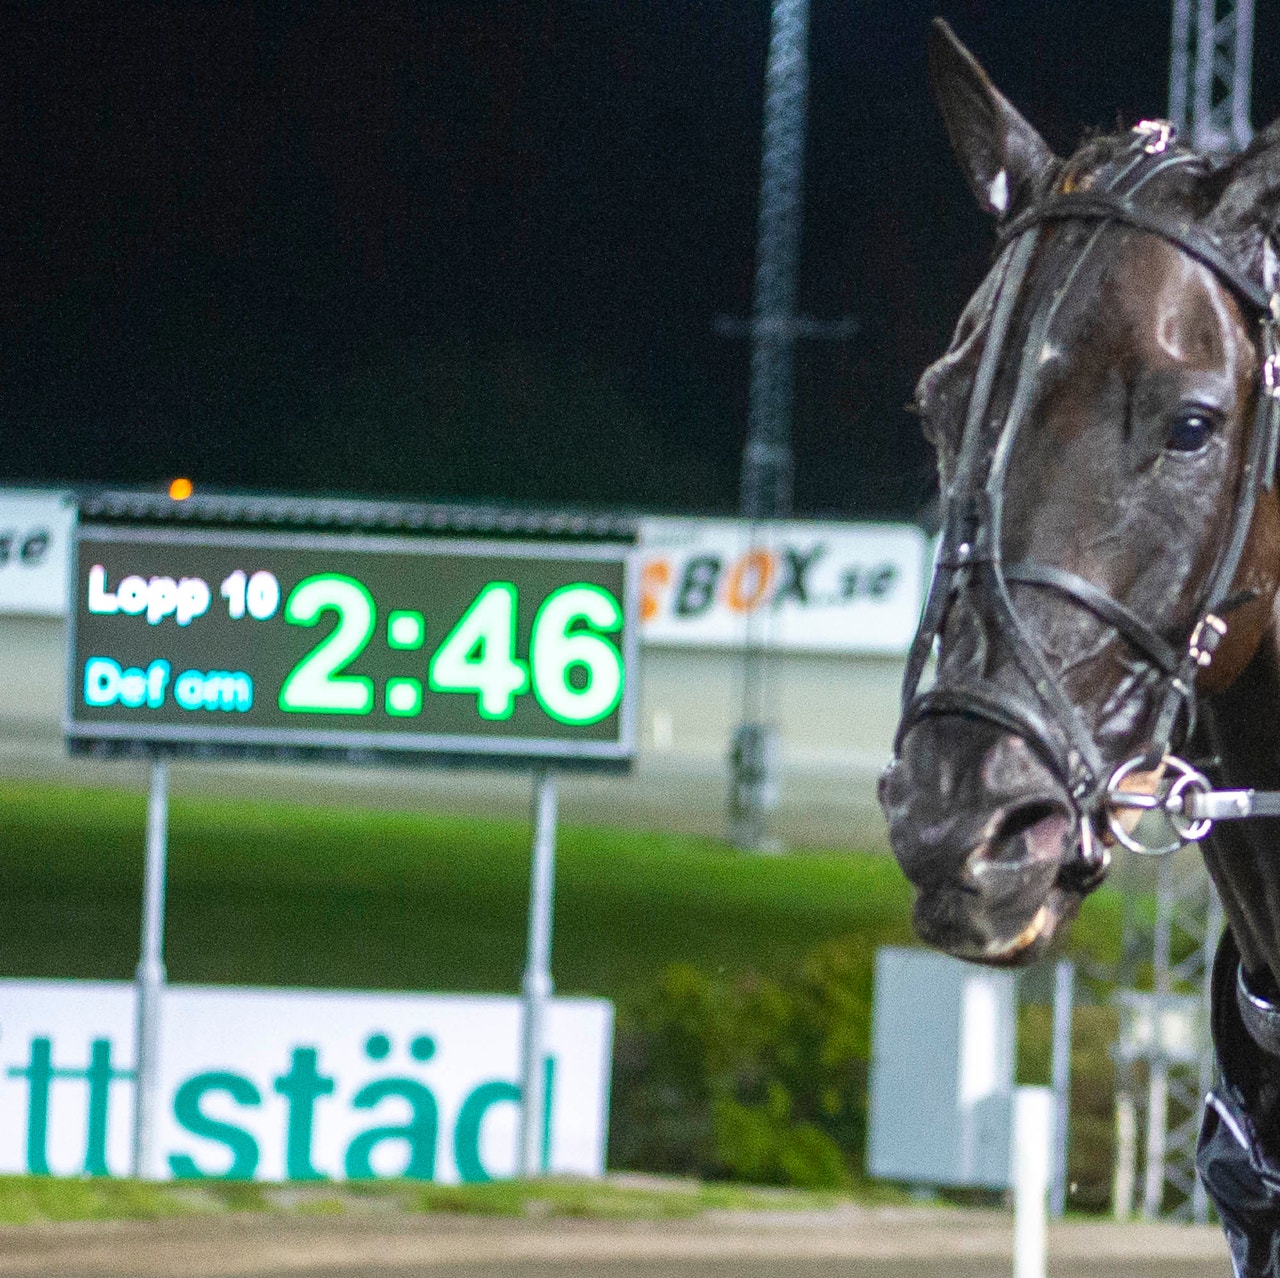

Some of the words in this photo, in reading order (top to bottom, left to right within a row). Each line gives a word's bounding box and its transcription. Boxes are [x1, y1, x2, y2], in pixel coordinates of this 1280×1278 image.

[88, 564, 212, 628] Lopp
[221, 569, 281, 621] 10
[278, 572, 625, 727] 2:46
[84, 656, 172, 710] Def
[174, 668, 254, 713] om
